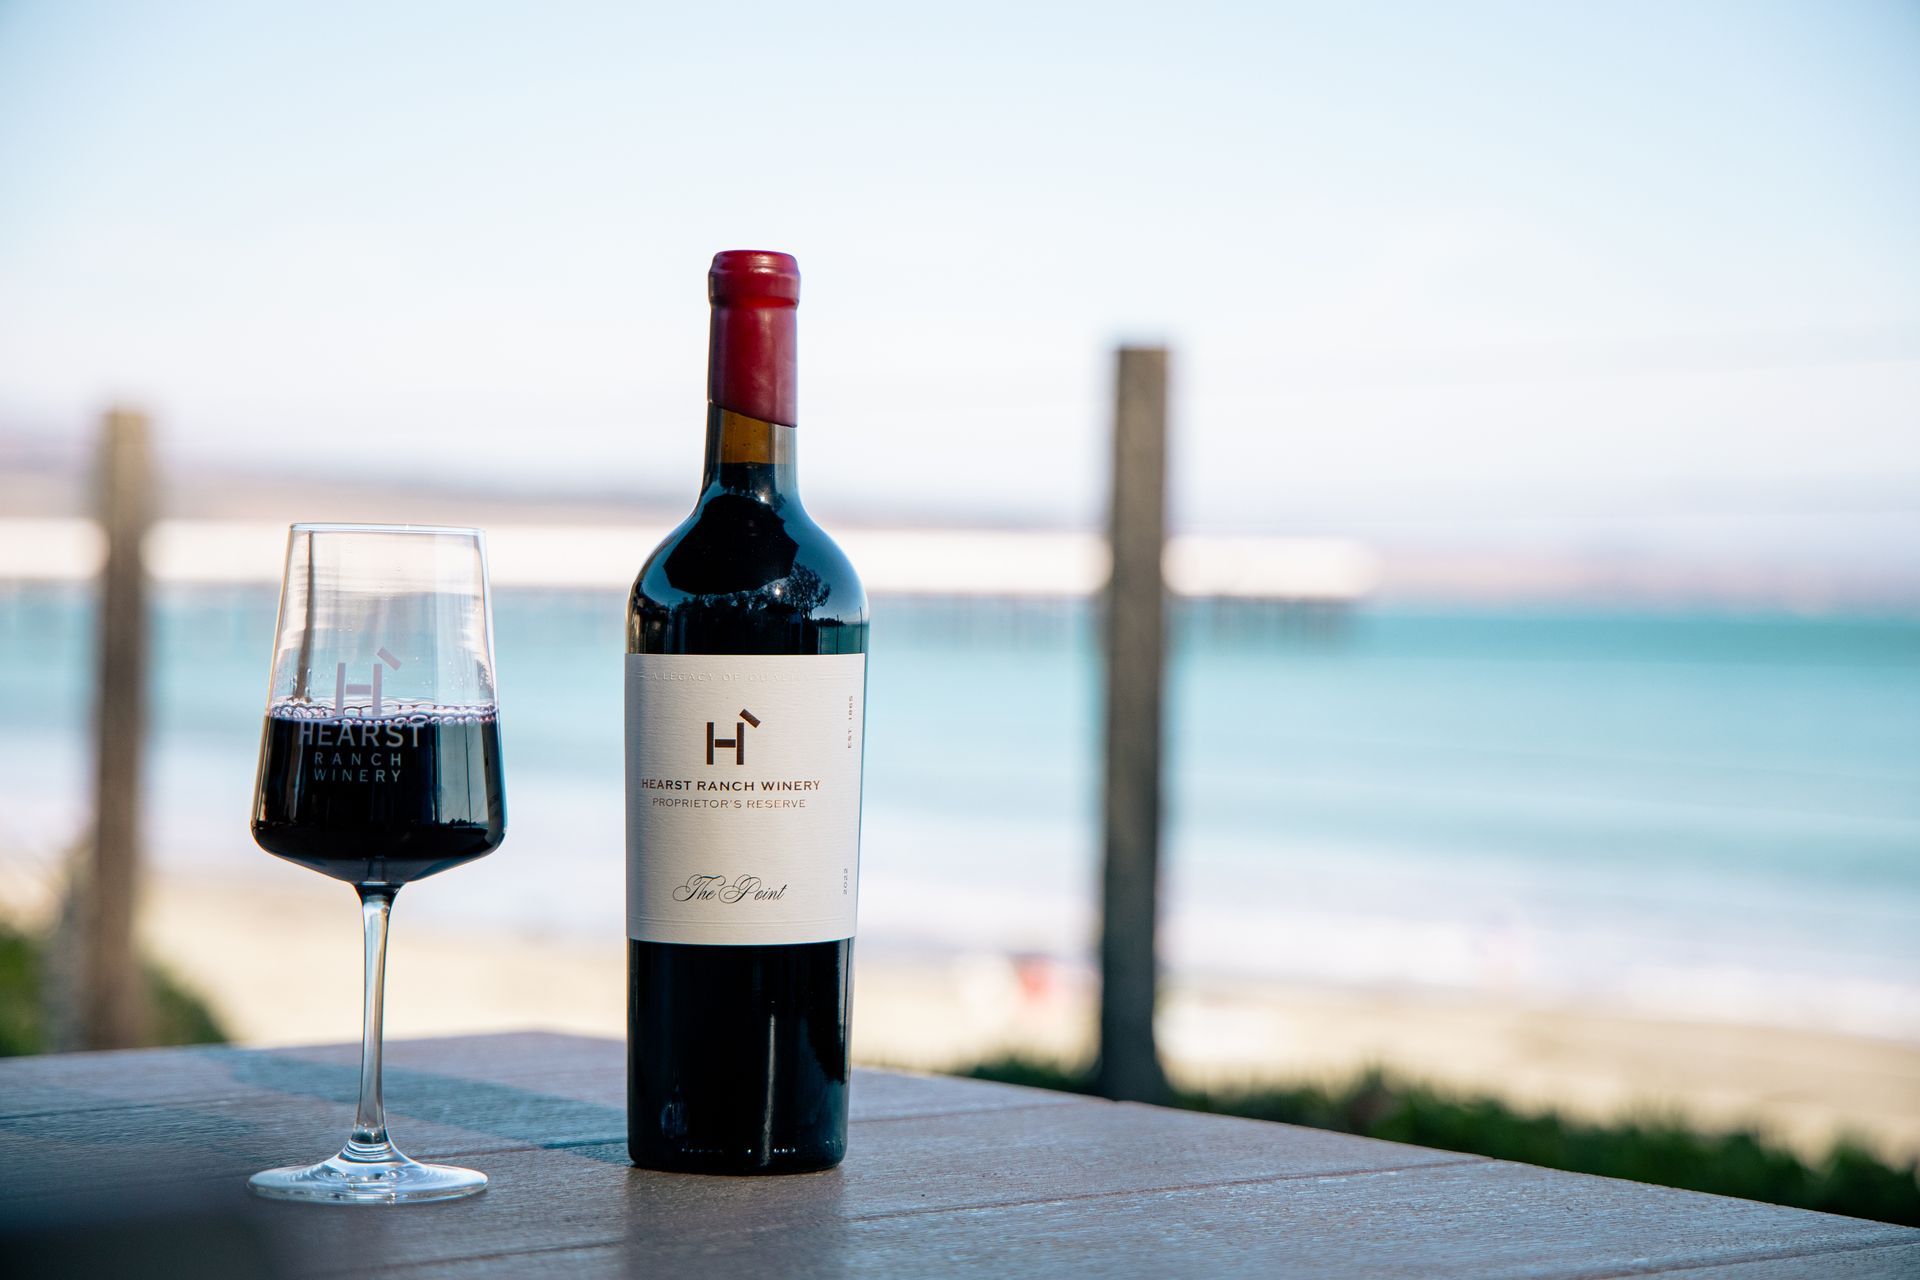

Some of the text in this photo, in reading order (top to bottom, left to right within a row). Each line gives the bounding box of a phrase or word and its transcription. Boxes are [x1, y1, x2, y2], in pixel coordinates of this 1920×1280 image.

[663, 671, 714, 681] LEGACY
[748, 671, 809, 682] QUALI
[298, 721, 425, 748] HEARST
[314, 751, 401, 767] RANCH
[313, 769, 401, 783] WINERY
[641, 778, 822, 792] HEARST RANCH WINERY
[652, 797, 807, 809] PROPRIETOR'S RESERVE
[672, 873, 788, 905] The Point
